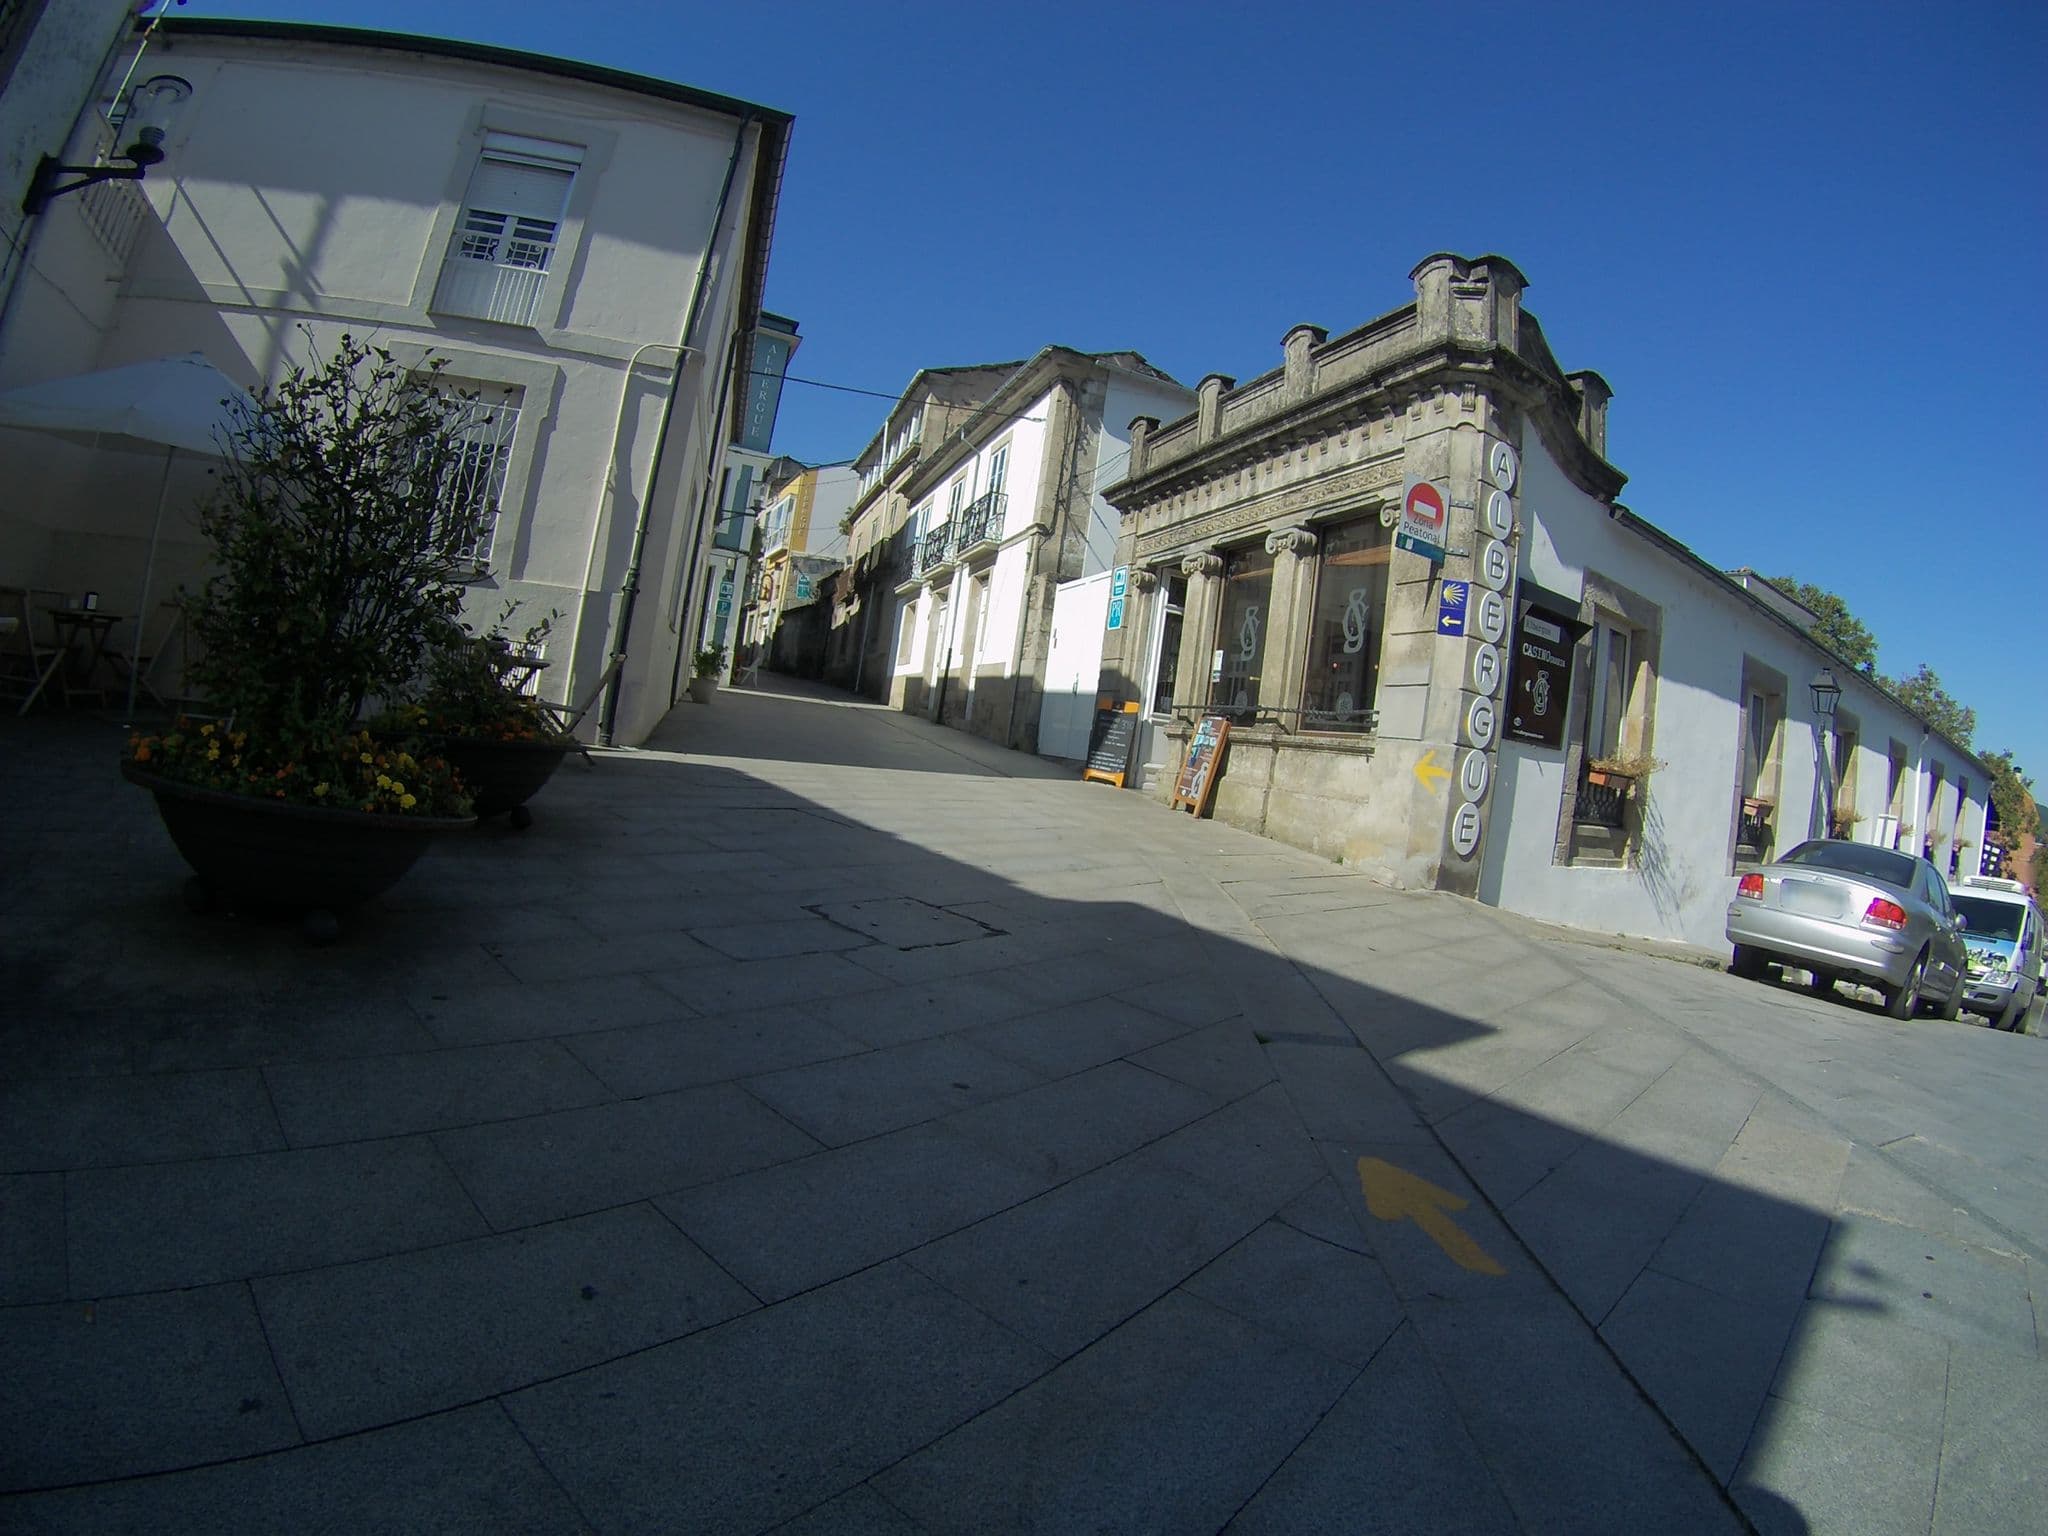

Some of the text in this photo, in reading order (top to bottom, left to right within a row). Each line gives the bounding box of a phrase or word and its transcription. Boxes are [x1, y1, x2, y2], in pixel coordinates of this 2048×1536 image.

[751, 344, 777, 437] ALBERGUE
[1403, 521, 1440, 544] Peatonal
[1413, 513, 1434, 530] Zona
[1459, 452, 1512, 844] ALBERGUE
